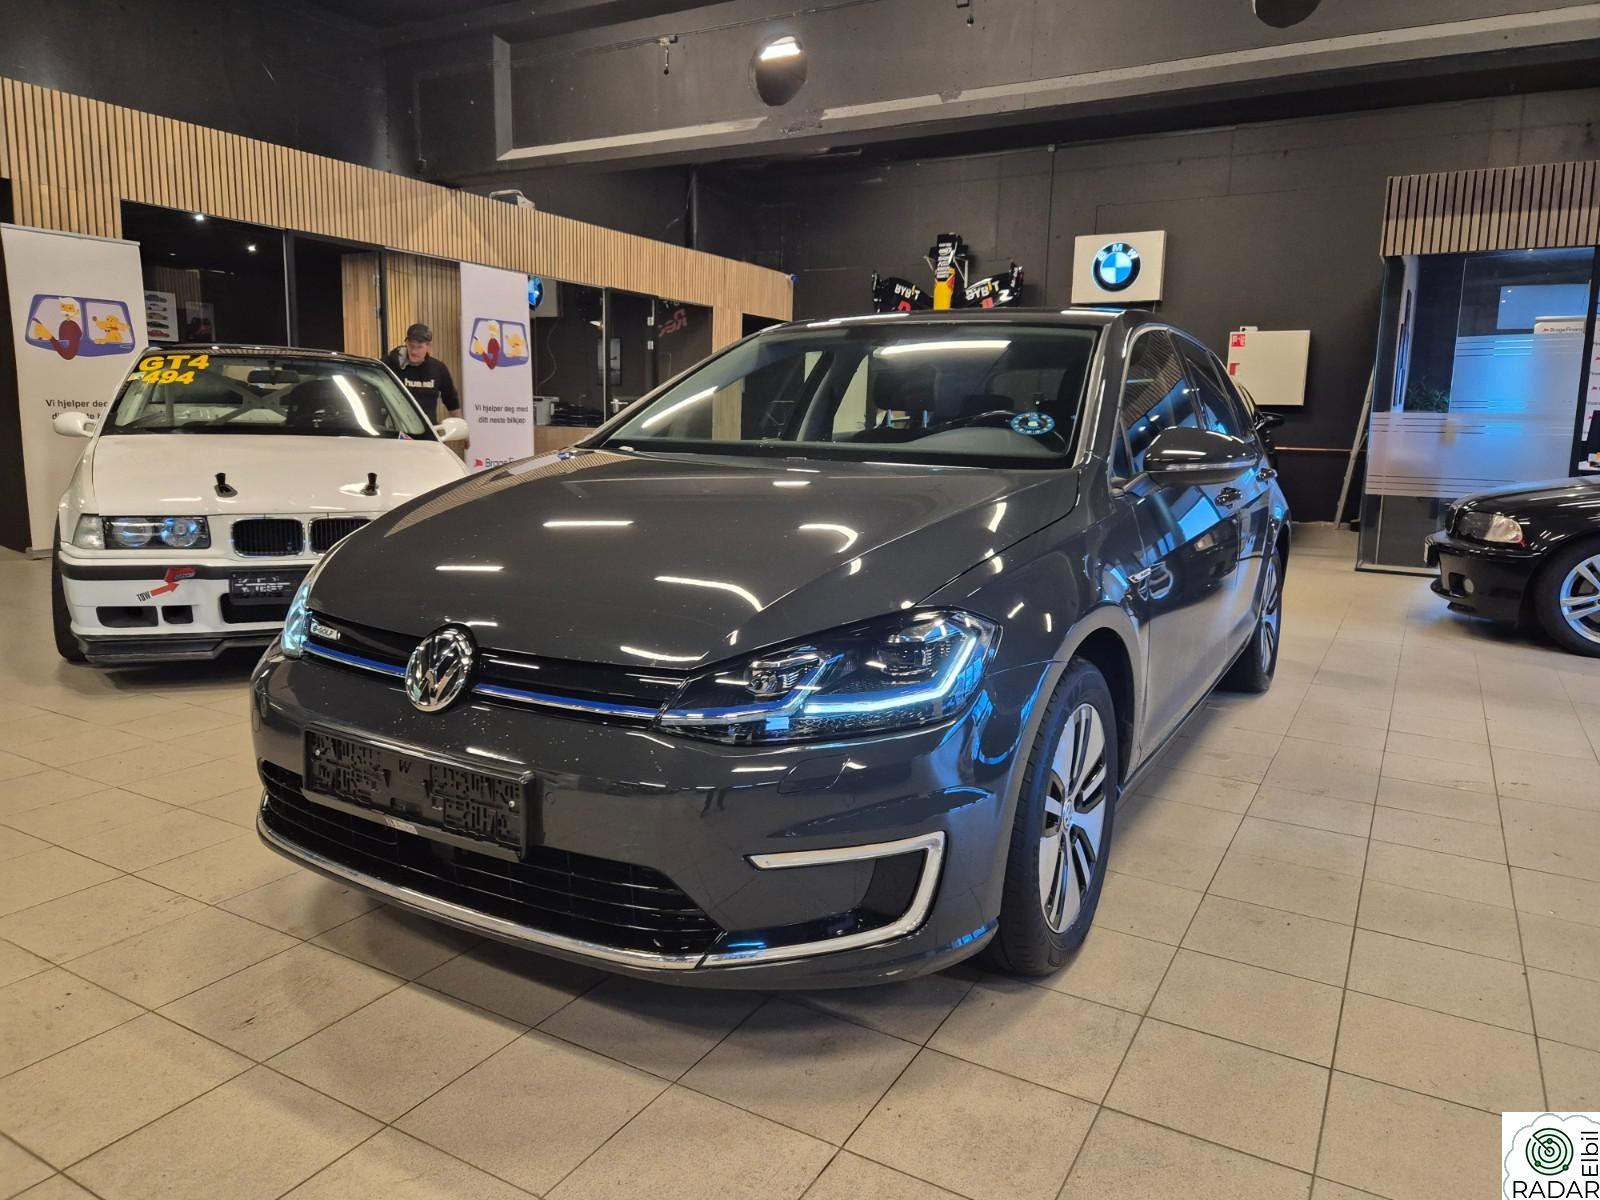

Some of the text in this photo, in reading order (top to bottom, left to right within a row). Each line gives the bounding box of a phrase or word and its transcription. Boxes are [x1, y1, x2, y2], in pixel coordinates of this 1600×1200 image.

[894, 284, 921, 301] BYBIT
[965, 280, 1000, 301] BYBIT
[138, 354, 209, 371] GT4
[142, 370, 195, 385] 494
[45, 399, 56, 407] Vi
[57, 399, 90, 409] hjelper
[474, 404, 482, 412] Vi
[482, 404, 503, 414] hjelper
[136, 590, 151, 603] TOW
